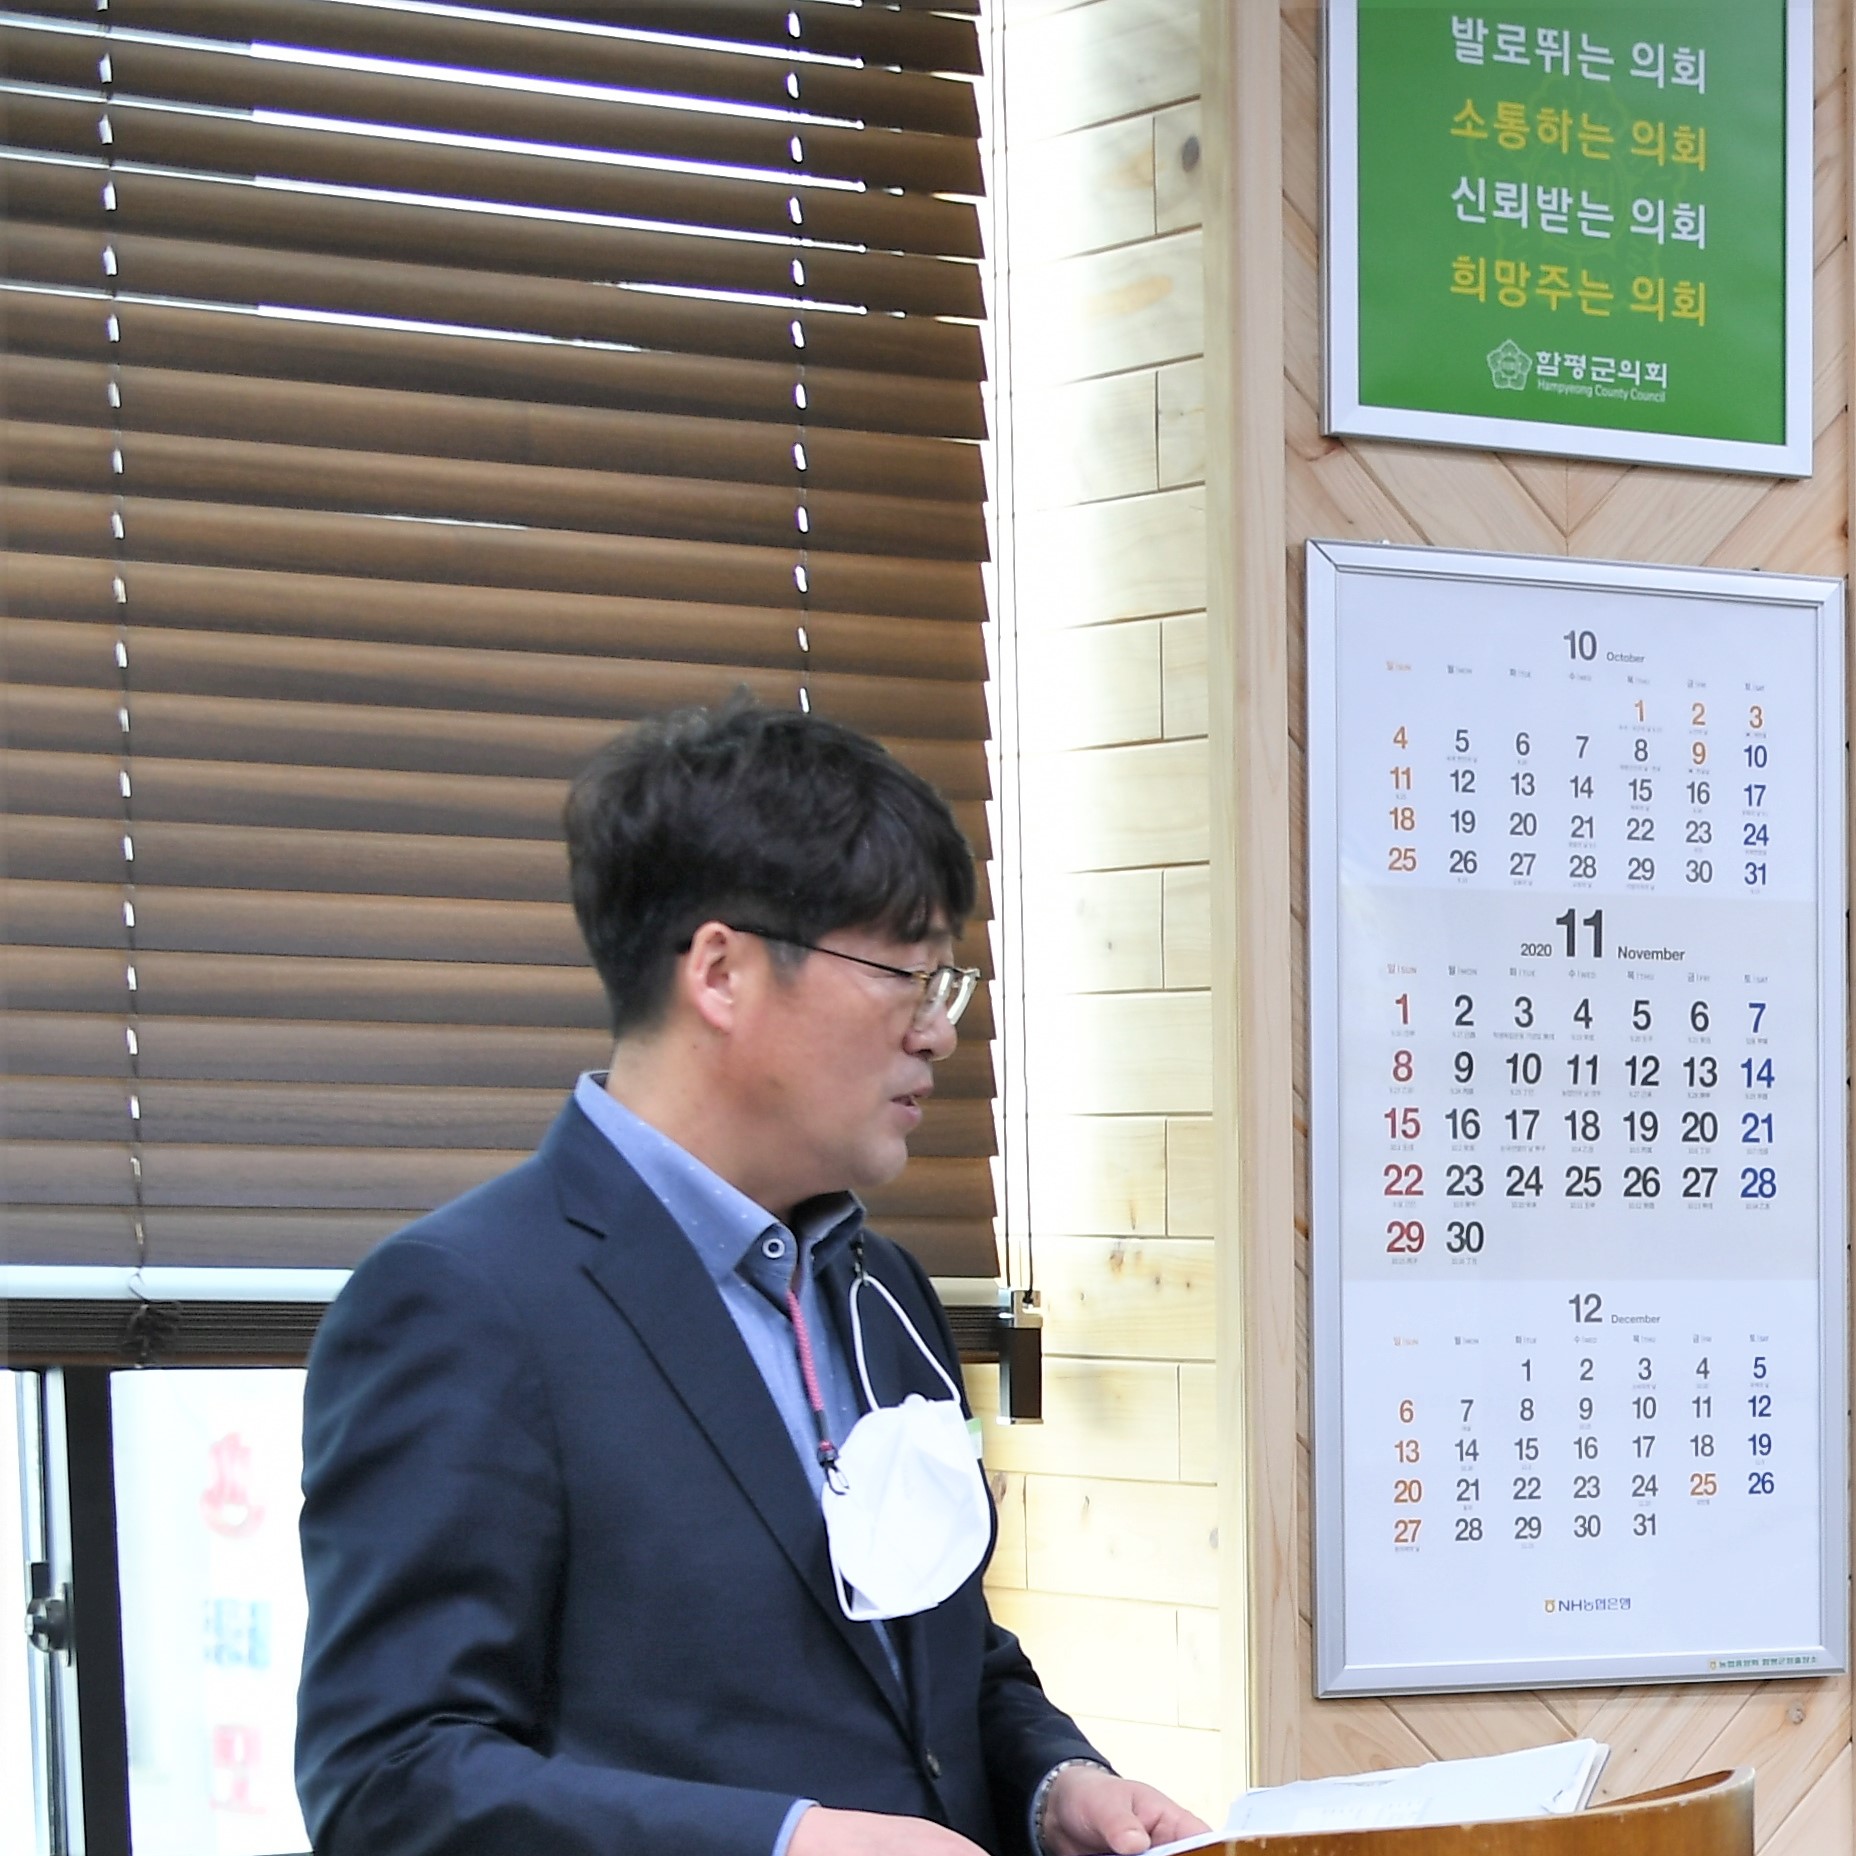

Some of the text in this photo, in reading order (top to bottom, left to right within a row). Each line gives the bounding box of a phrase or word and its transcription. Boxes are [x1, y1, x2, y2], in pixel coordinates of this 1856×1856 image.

[1452, 15, 1705, 94] 발로뛰는 의회
[1450, 98, 1706, 172] 소통하는 의회
[1451, 176, 1705, 250] 신뢰받는 의회
[1450, 256, 1705, 327] 희망주는 의회
[1536, 351, 1667, 389] 함평군의회
[1595, 384, 1628, 400] County
[1630, 388, 1666, 402] Council
[1563, 630, 1645, 663] 10 October
[1634, 699, 1763, 730] 1 2 3
[1392, 725, 1768, 768] 4 5 6 7 8 9 10
[1389, 766, 1767, 807] 11 12 13 14 15 16 17
[1389, 806, 1770, 847] 18 19 20 21 22 23 24
[1388, 847, 1766, 886] 25 26 27 28 29 30 31
[1520, 908, 1686, 961] 2020 11 November
[1395, 993, 1766, 1034] 1 2 3 4 5 6 7
[1392, 1050, 1776, 1089] 8 9 10 11 12 13 14
[1384, 1107, 1773, 1144] 15 16 17 18 19 20 21
[1383, 1163, 1777, 1199] 22 23 24 25 26 27 28
[1386, 1220, 1484, 1254] 29 30
[1568, 1293, 1661, 1324] 12 December
[1521, 1356, 1767, 1382] 1 2 3 4 5
[1399, 1394, 1772, 1424] 6 7 8 9 10 11 12
[1394, 1433, 1772, 1464] 13 14 15 16 17 18 19
[1393, 1471, 1775, 1504] 20 21 22 23 24 25 26
[1394, 1513, 1656, 1543] 27 28 29 30 31
